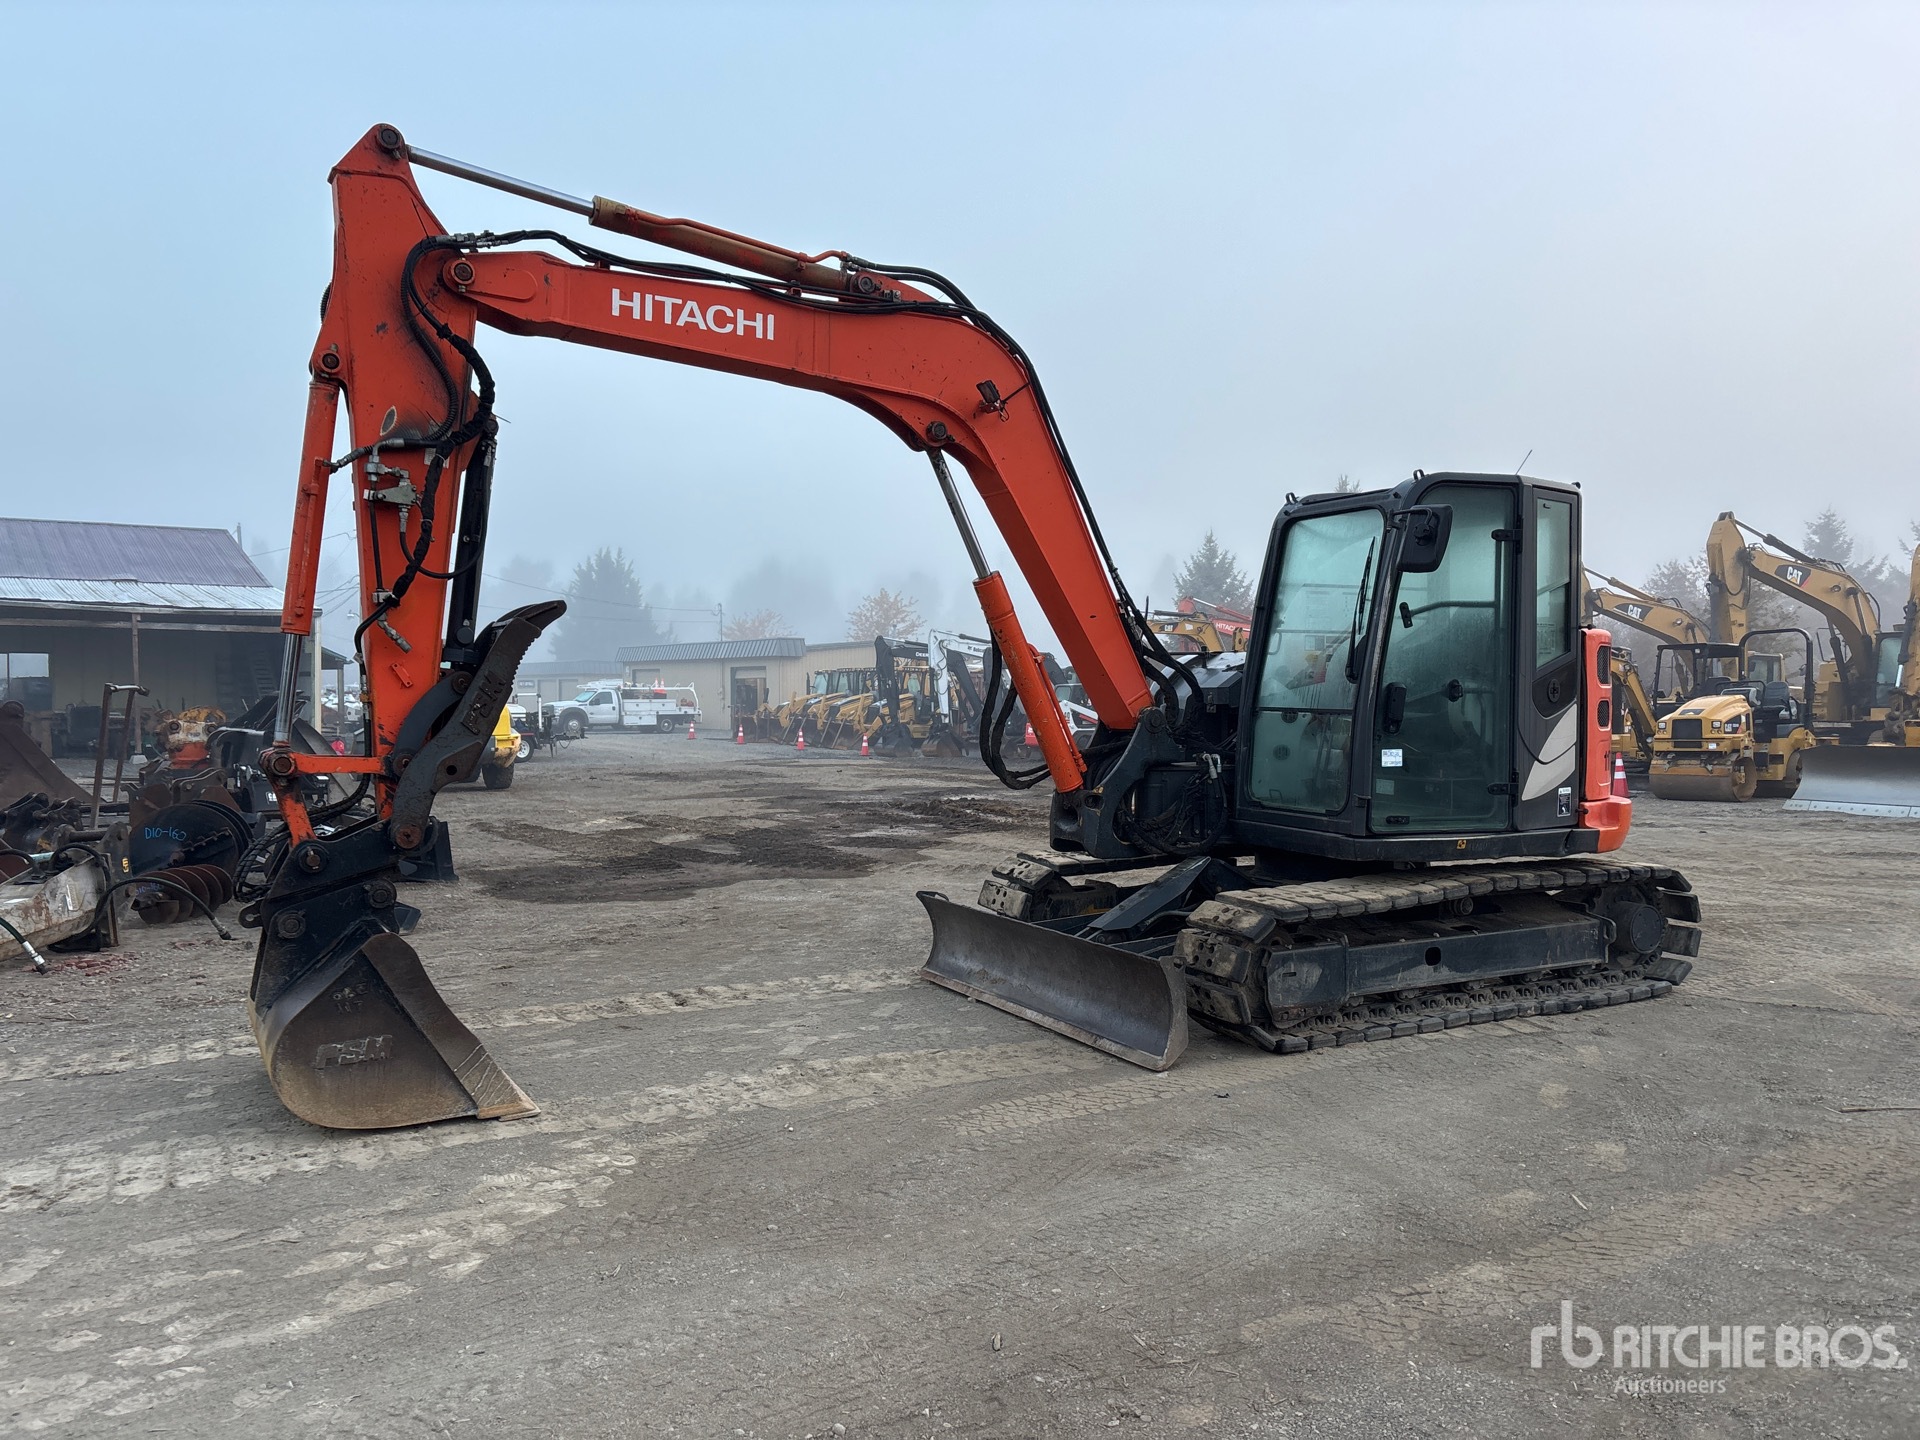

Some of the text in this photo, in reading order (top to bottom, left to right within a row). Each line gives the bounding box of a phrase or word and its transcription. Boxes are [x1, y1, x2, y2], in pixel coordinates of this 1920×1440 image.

[611, 288, 775, 340] HITACHI
[1786, 566, 1803, 585] CAT
[1627, 604, 1642, 619] CAT
[1164, 624, 1173, 632] CAT
